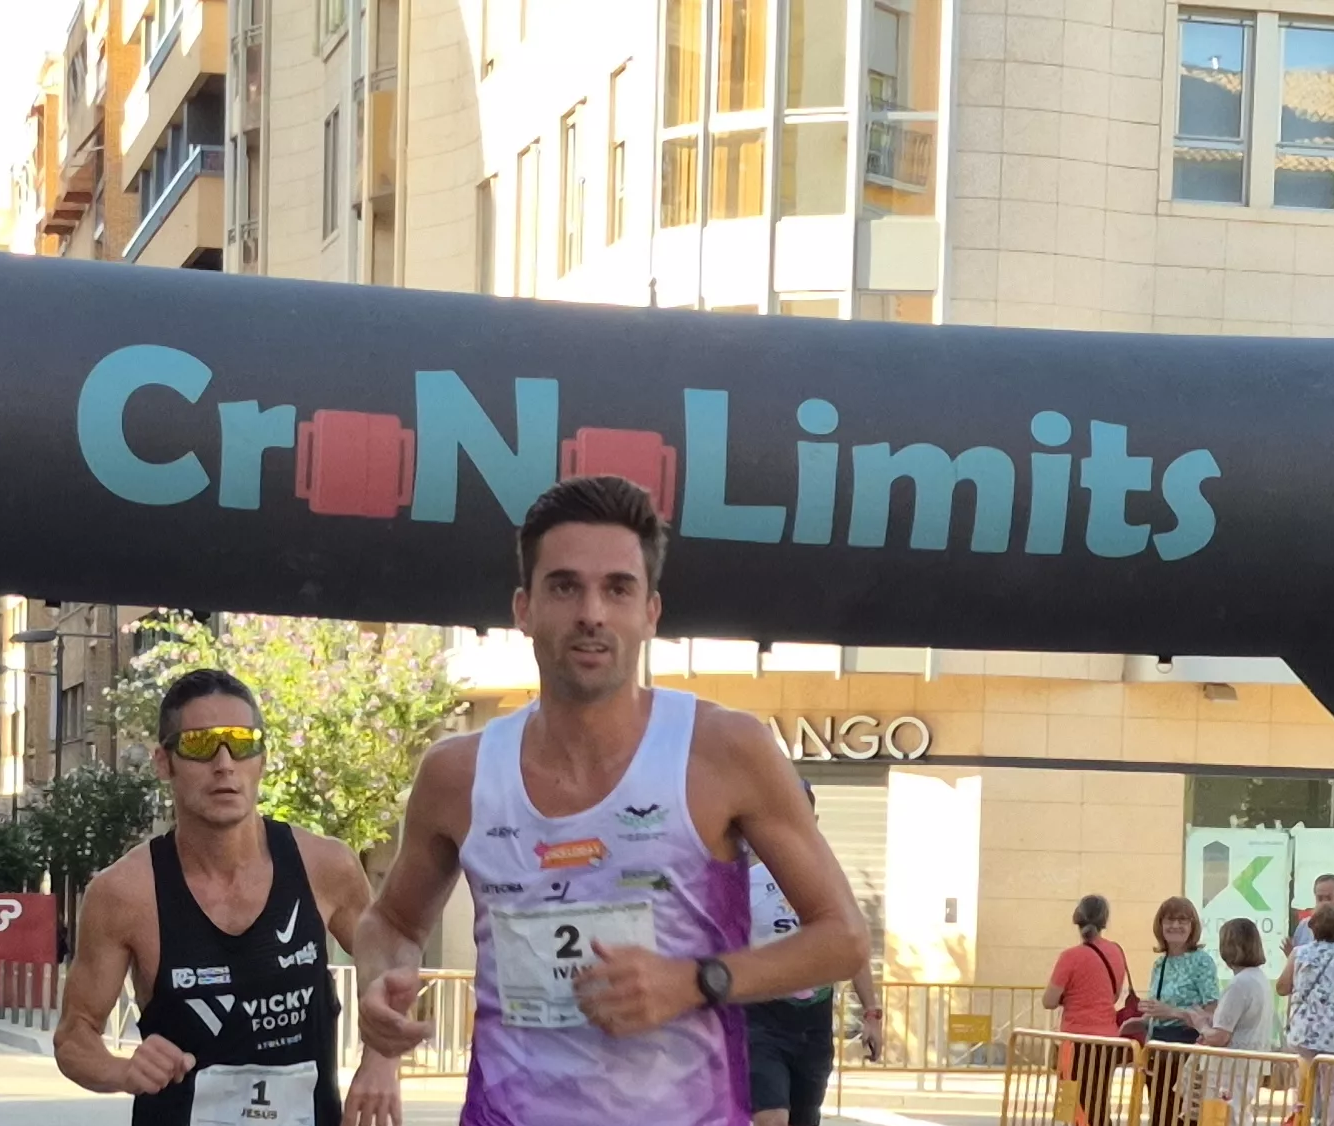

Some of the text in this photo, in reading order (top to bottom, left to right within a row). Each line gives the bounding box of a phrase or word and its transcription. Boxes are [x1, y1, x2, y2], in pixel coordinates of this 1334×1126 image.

[769, 715, 930, 760] NGO
[554, 924, 582, 959] 2
[242, 986, 314, 1016] VICKY
[252, 1009, 306, 1031] FOODS
[251, 1080, 271, 1106] 1
